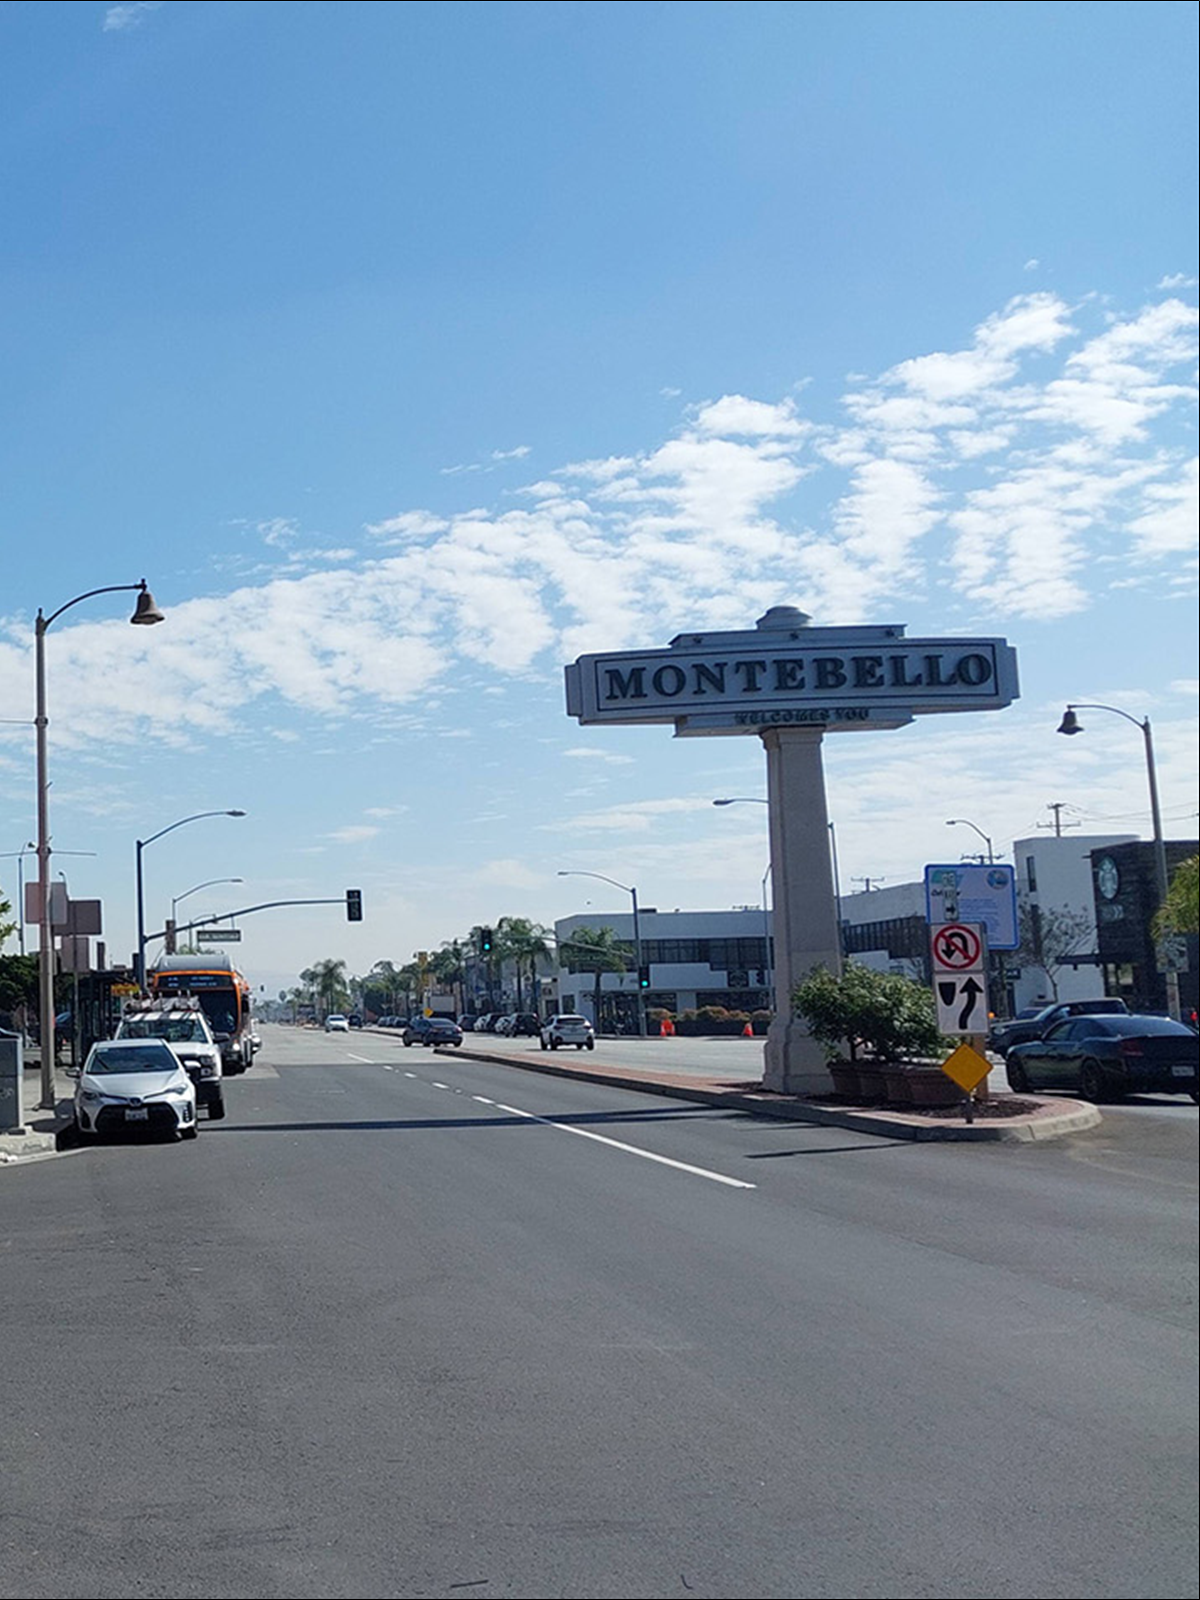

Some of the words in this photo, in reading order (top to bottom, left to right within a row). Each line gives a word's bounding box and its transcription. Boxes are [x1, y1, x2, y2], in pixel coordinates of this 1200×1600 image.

[604, 653, 993, 700] MONTEBELLO
[735, 709, 830, 725] WELCOMES
[834, 707, 869, 721] YOU
